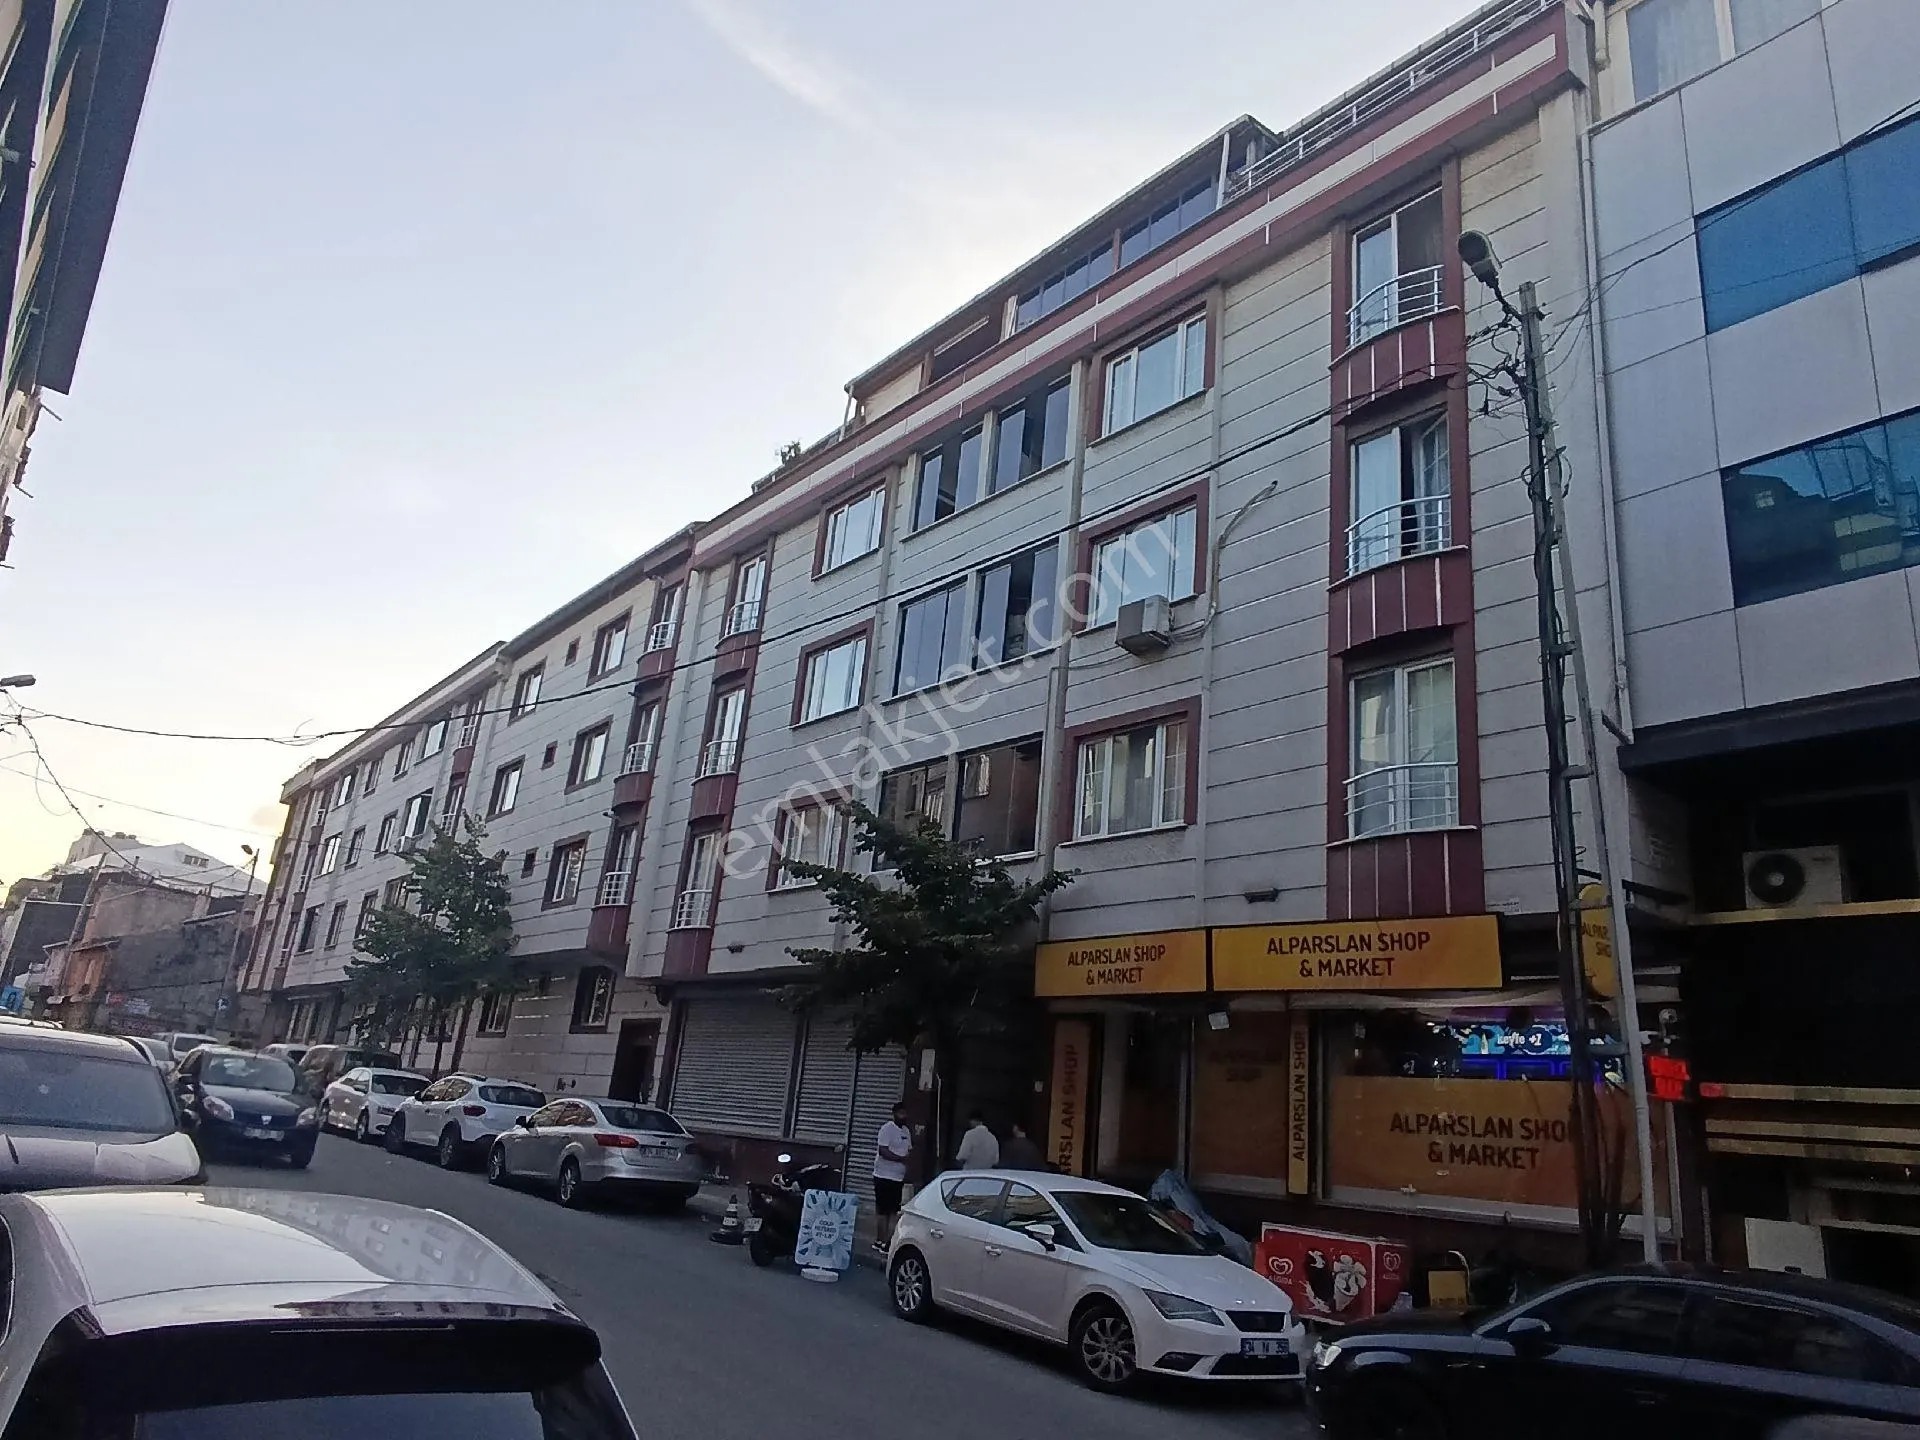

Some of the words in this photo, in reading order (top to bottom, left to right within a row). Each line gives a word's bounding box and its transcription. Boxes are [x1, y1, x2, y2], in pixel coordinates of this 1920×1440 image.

[1067, 948, 1131, 966] ALPARSLAN
[1134, 944, 1166, 962] SHOP
[1267, 934, 1372, 955] ALPARSLAN
[1377, 931, 1431, 951] SHOP
[1086, 971, 1095, 985] &
[1098, 967, 1145, 984] MARKET
[1299, 960, 1314, 977] &
[1318, 957, 1395, 977] MARKET
[1292, 1074, 1306, 1162] ALPARSLAN
[1389, 1112, 1514, 1139] ALPARSLAN
[1427, 1141, 1443, 1163] &
[1448, 1142, 1540, 1170] MARKET
